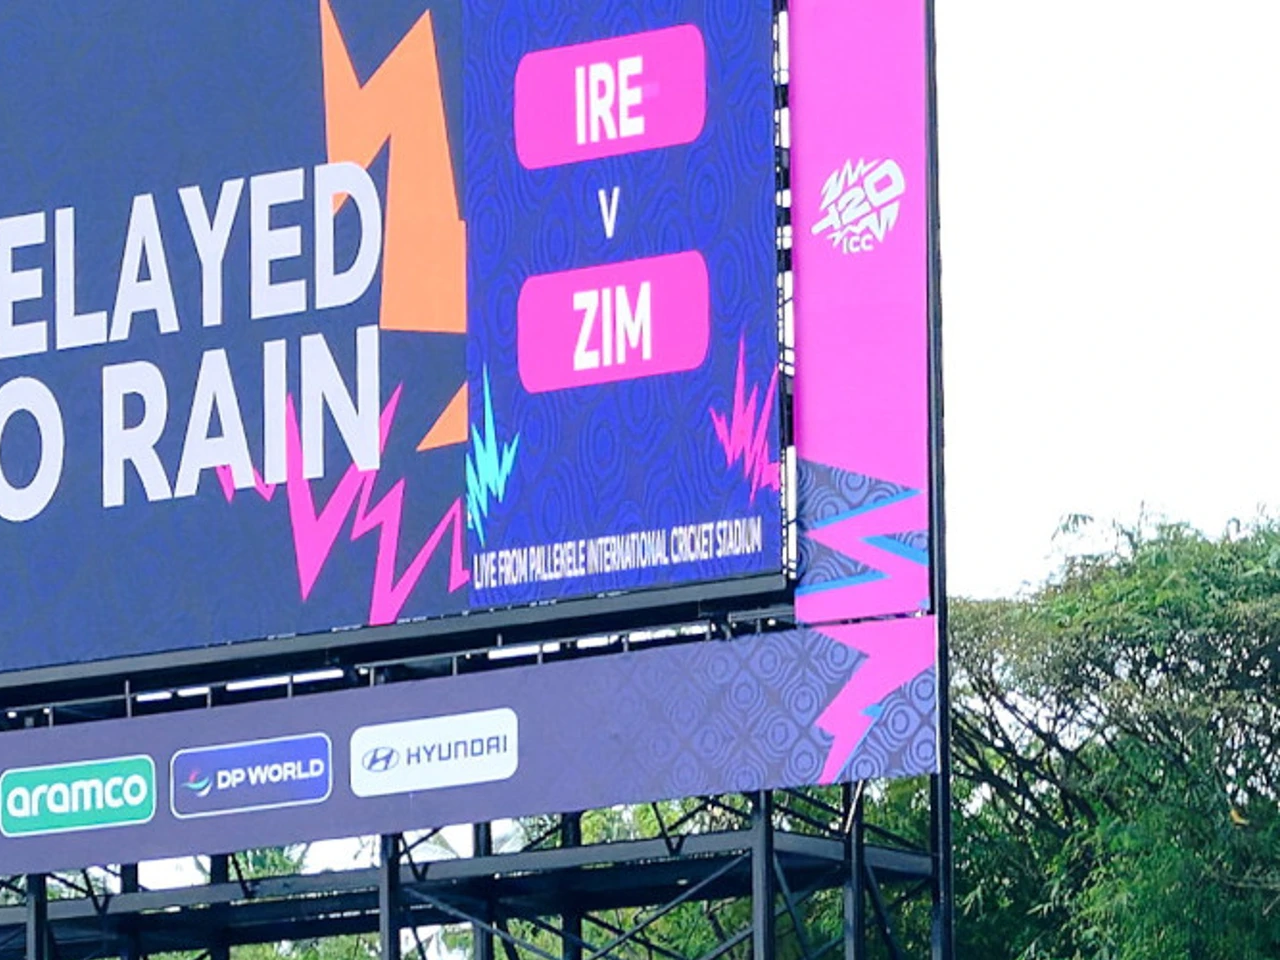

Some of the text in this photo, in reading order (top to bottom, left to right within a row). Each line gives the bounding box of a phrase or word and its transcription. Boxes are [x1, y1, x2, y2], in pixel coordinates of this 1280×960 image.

[574, 56, 644, 145] IRE
[843, 234, 874, 254] ICC
[572, 281, 652, 371] ZIM
[102, 324, 380, 508] RAIN
[473, 516, 763, 589] LIVE FROM PALLEKELE INTERNATIONAL CRICKET STADIUM
[217, 758, 325, 790] DP WORLD
[406, 735, 508, 765] HYUNDAI
[6, 774, 148, 818] aramco
